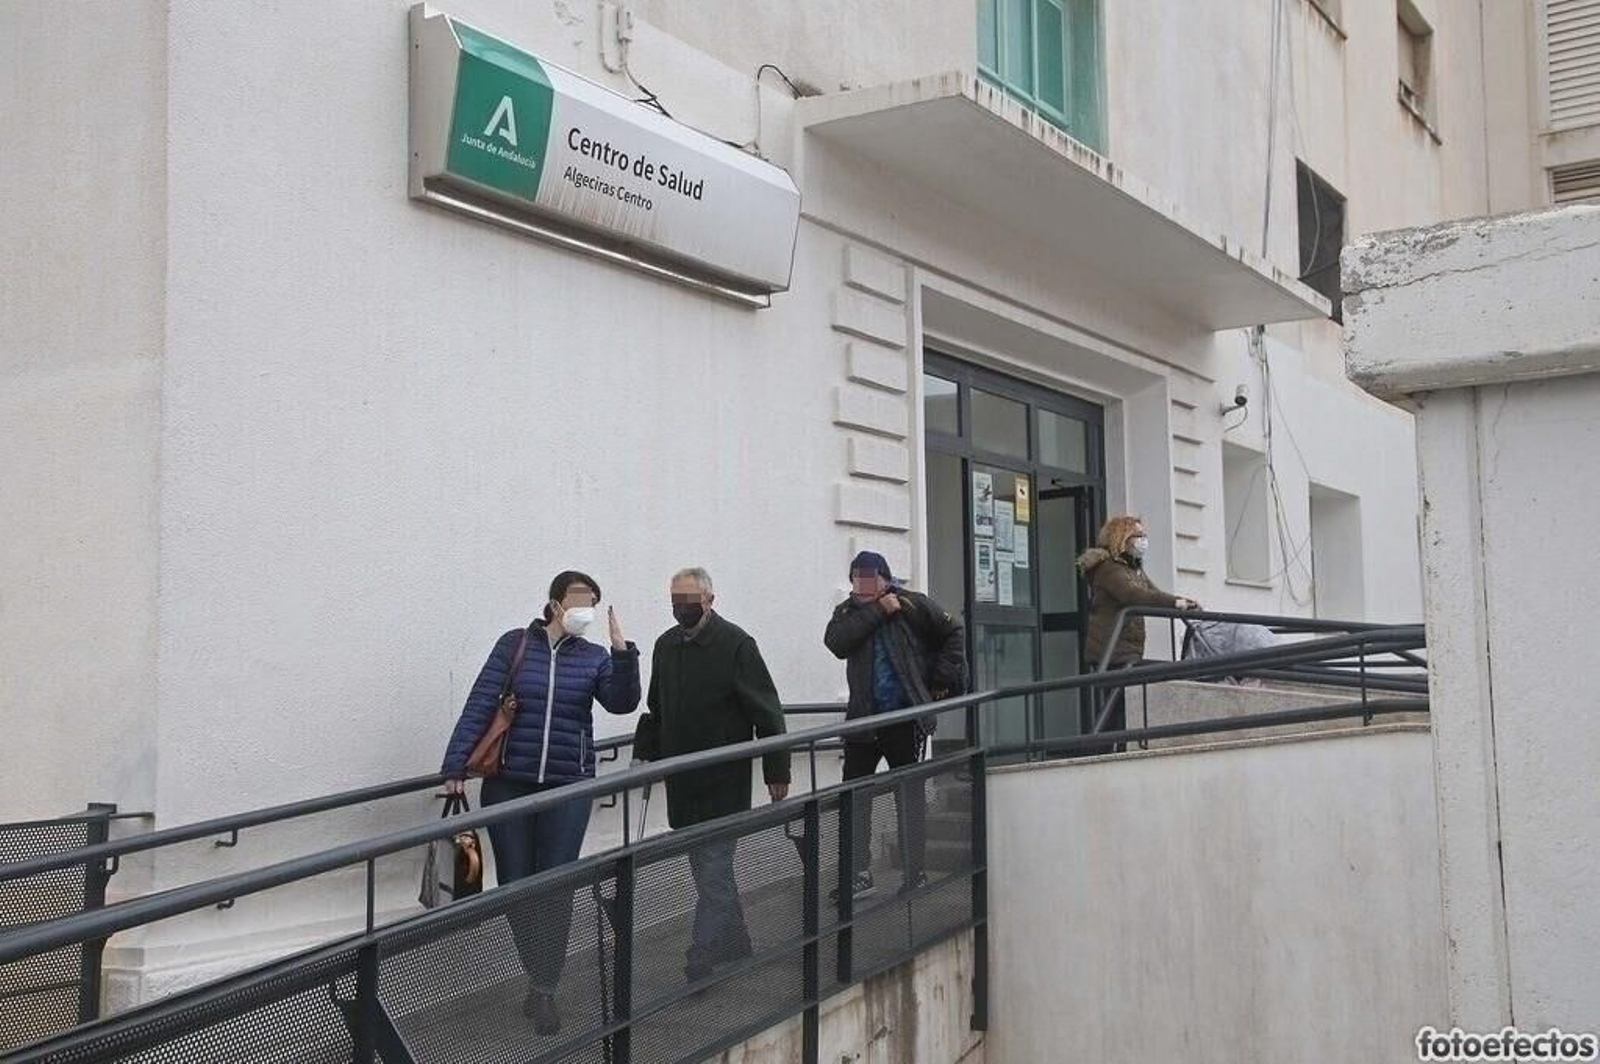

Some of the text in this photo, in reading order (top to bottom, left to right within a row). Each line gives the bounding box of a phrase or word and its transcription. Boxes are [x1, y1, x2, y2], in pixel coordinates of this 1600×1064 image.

[462, 133, 485, 150] Junta
[486, 143, 497, 155] de
[568, 128, 704, 200] Centro de Salud
[564, 166, 653, 210] Algeciras Centro
